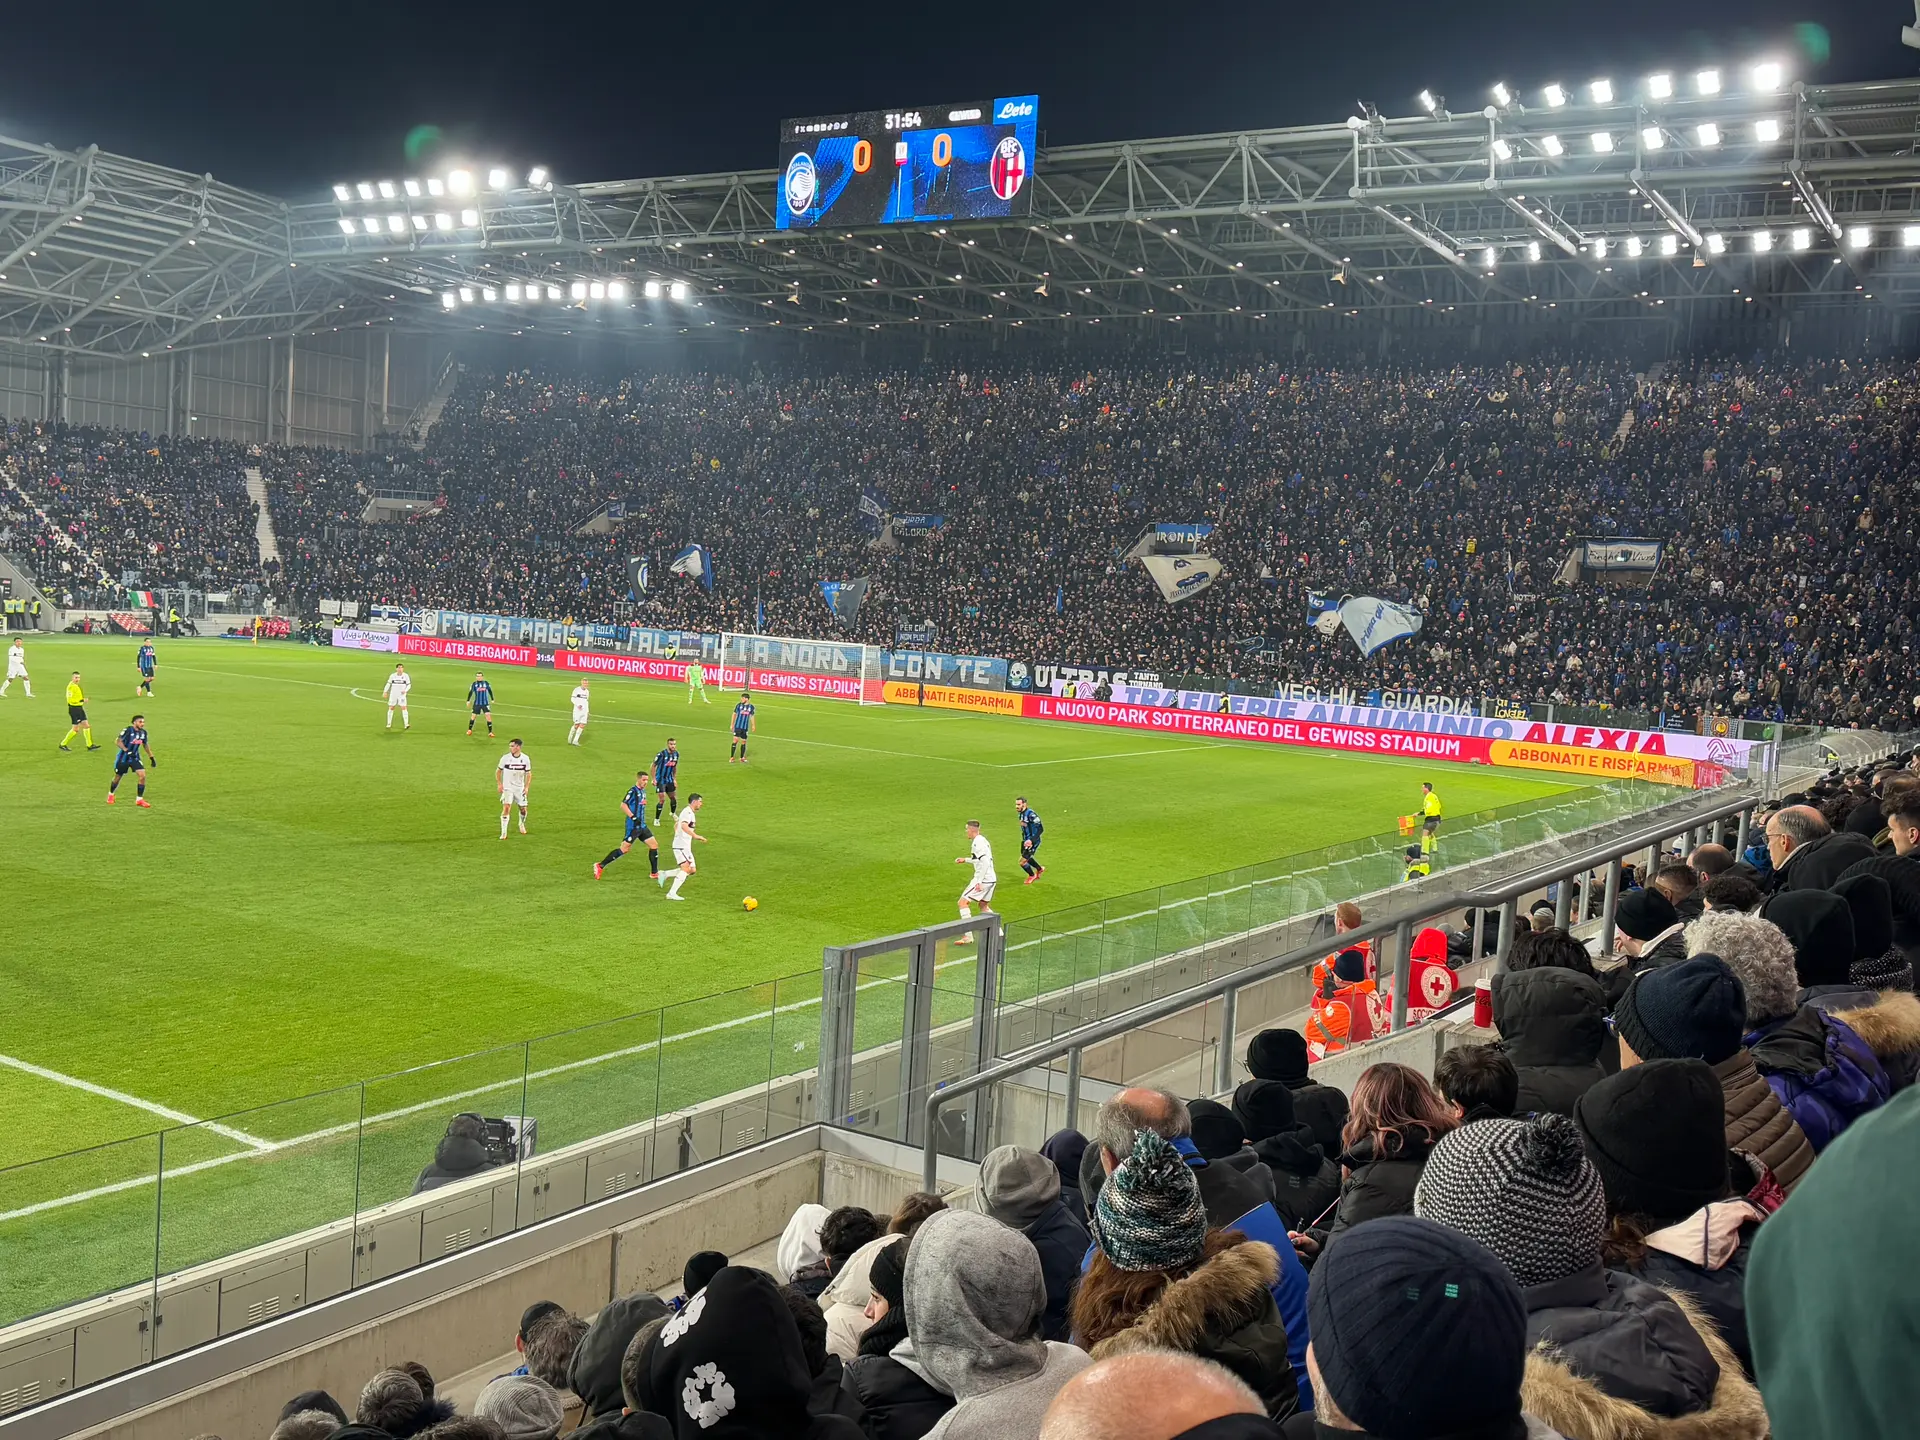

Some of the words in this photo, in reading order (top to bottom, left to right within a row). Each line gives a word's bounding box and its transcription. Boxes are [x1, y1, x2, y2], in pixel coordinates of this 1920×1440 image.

[885, 112, 922, 130] 31:54
[997, 102, 1033, 119] Lete
[853, 139, 873, 174] 0
[932, 133, 953, 168] 0
[404, 638, 427, 652] INFO
[429, 641, 442, 653] SU
[444, 642, 530, 662] ATB.BERGAMO.IT
[442, 613, 511, 640] FORZA
[781, 643, 848, 671] NORD
[889, 654, 942, 680] CON
[955, 659, 992, 685] TE
[536, 653, 555, 663] 31:54
[567, 654, 577, 667] IL
[579, 655, 616, 671] NUOVO
[617, 660, 647, 674] PARK
[948, 692, 956, 703] E
[957, 693, 1015, 710] RISPARMIA
[1381, 691, 1473, 716] GUARDIA
[1040, 700, 1053, 715] IL
[1055, 701, 1105, 720] NUOVO
[1108, 707, 1149, 725] PARK
[1152, 711, 1269, 737] SOTTERRANEO
[1272, 723, 1305, 741] DEL
[1309, 726, 1376, 747] GEWISS
[1379, 733, 1461, 756] STADIUM
[1305, 704, 1513, 739] ALLUMINIO
[1522, 723, 1667, 756] ALEXIA
[1508, 747, 1585, 767] ABBONATI
[1589, 755, 1599, 768] E
